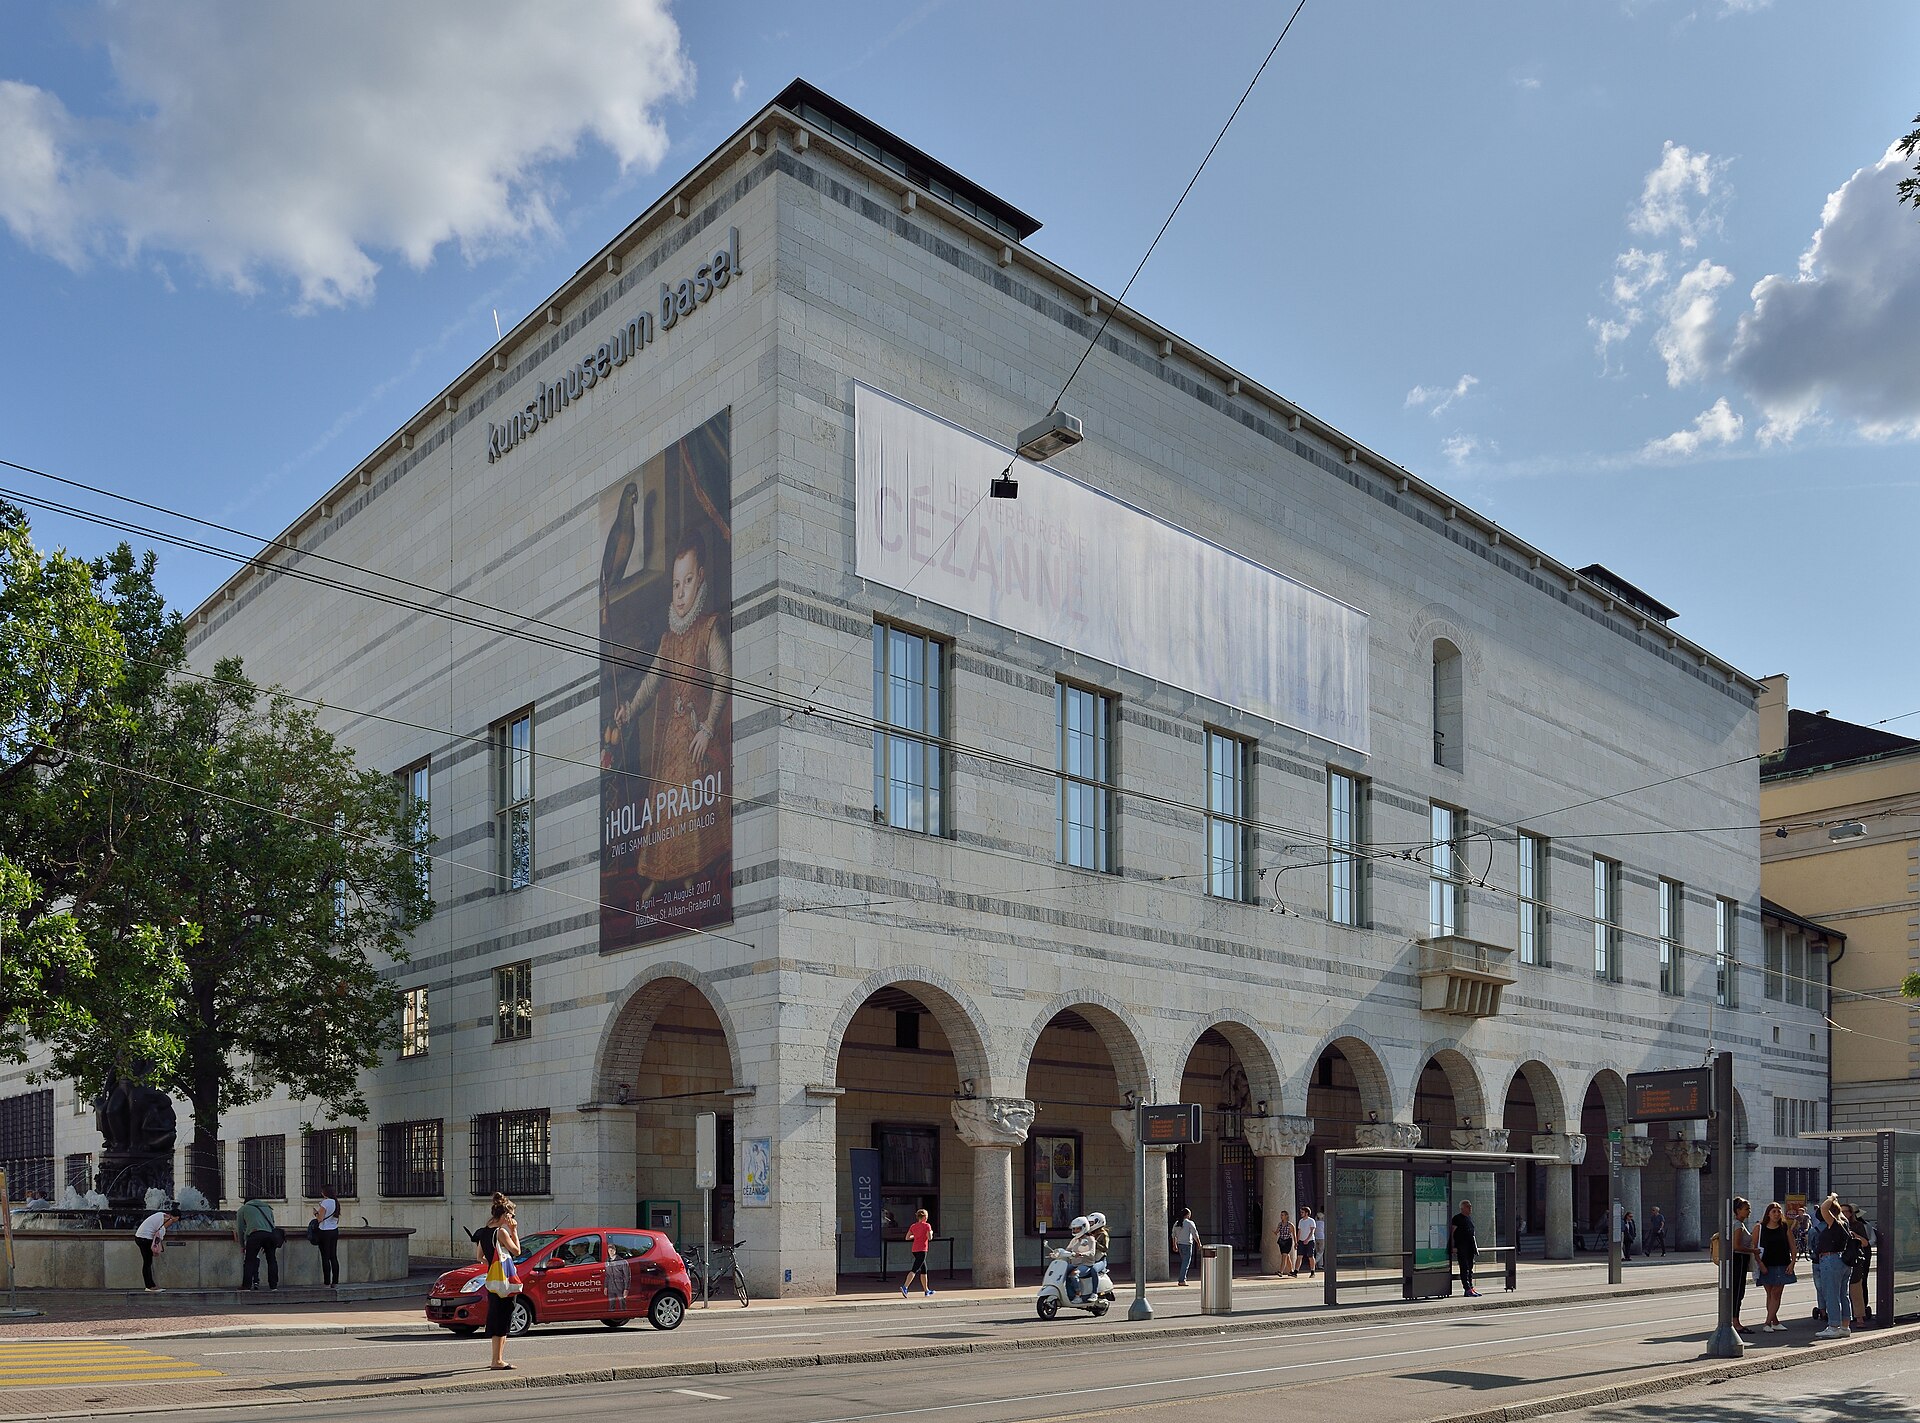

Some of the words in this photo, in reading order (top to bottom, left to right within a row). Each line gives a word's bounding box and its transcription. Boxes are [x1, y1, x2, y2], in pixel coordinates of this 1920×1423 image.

[487, 309, 653, 464] kunstmuseum
[659, 226, 743, 331] basel
[874, 484, 1090, 625] CÉZANNE
[606, 797, 653, 845] ¡HOLA
[656, 771, 722, 823] PRADO!
[611, 841, 627, 858] ZWEI
[628, 825, 675, 852] SAMMLUNGEN
[677, 822, 687, 835] IM
[689, 812, 715, 832] DIALOG
[673, 885, 695, 902] August
[696, 880, 711, 895] 2017
[712, 893, 721, 906] 20
[1881, 1139, 1889, 1187] Kunstmuseum
[742, 1185, 766, 1196] CÉZANNE
